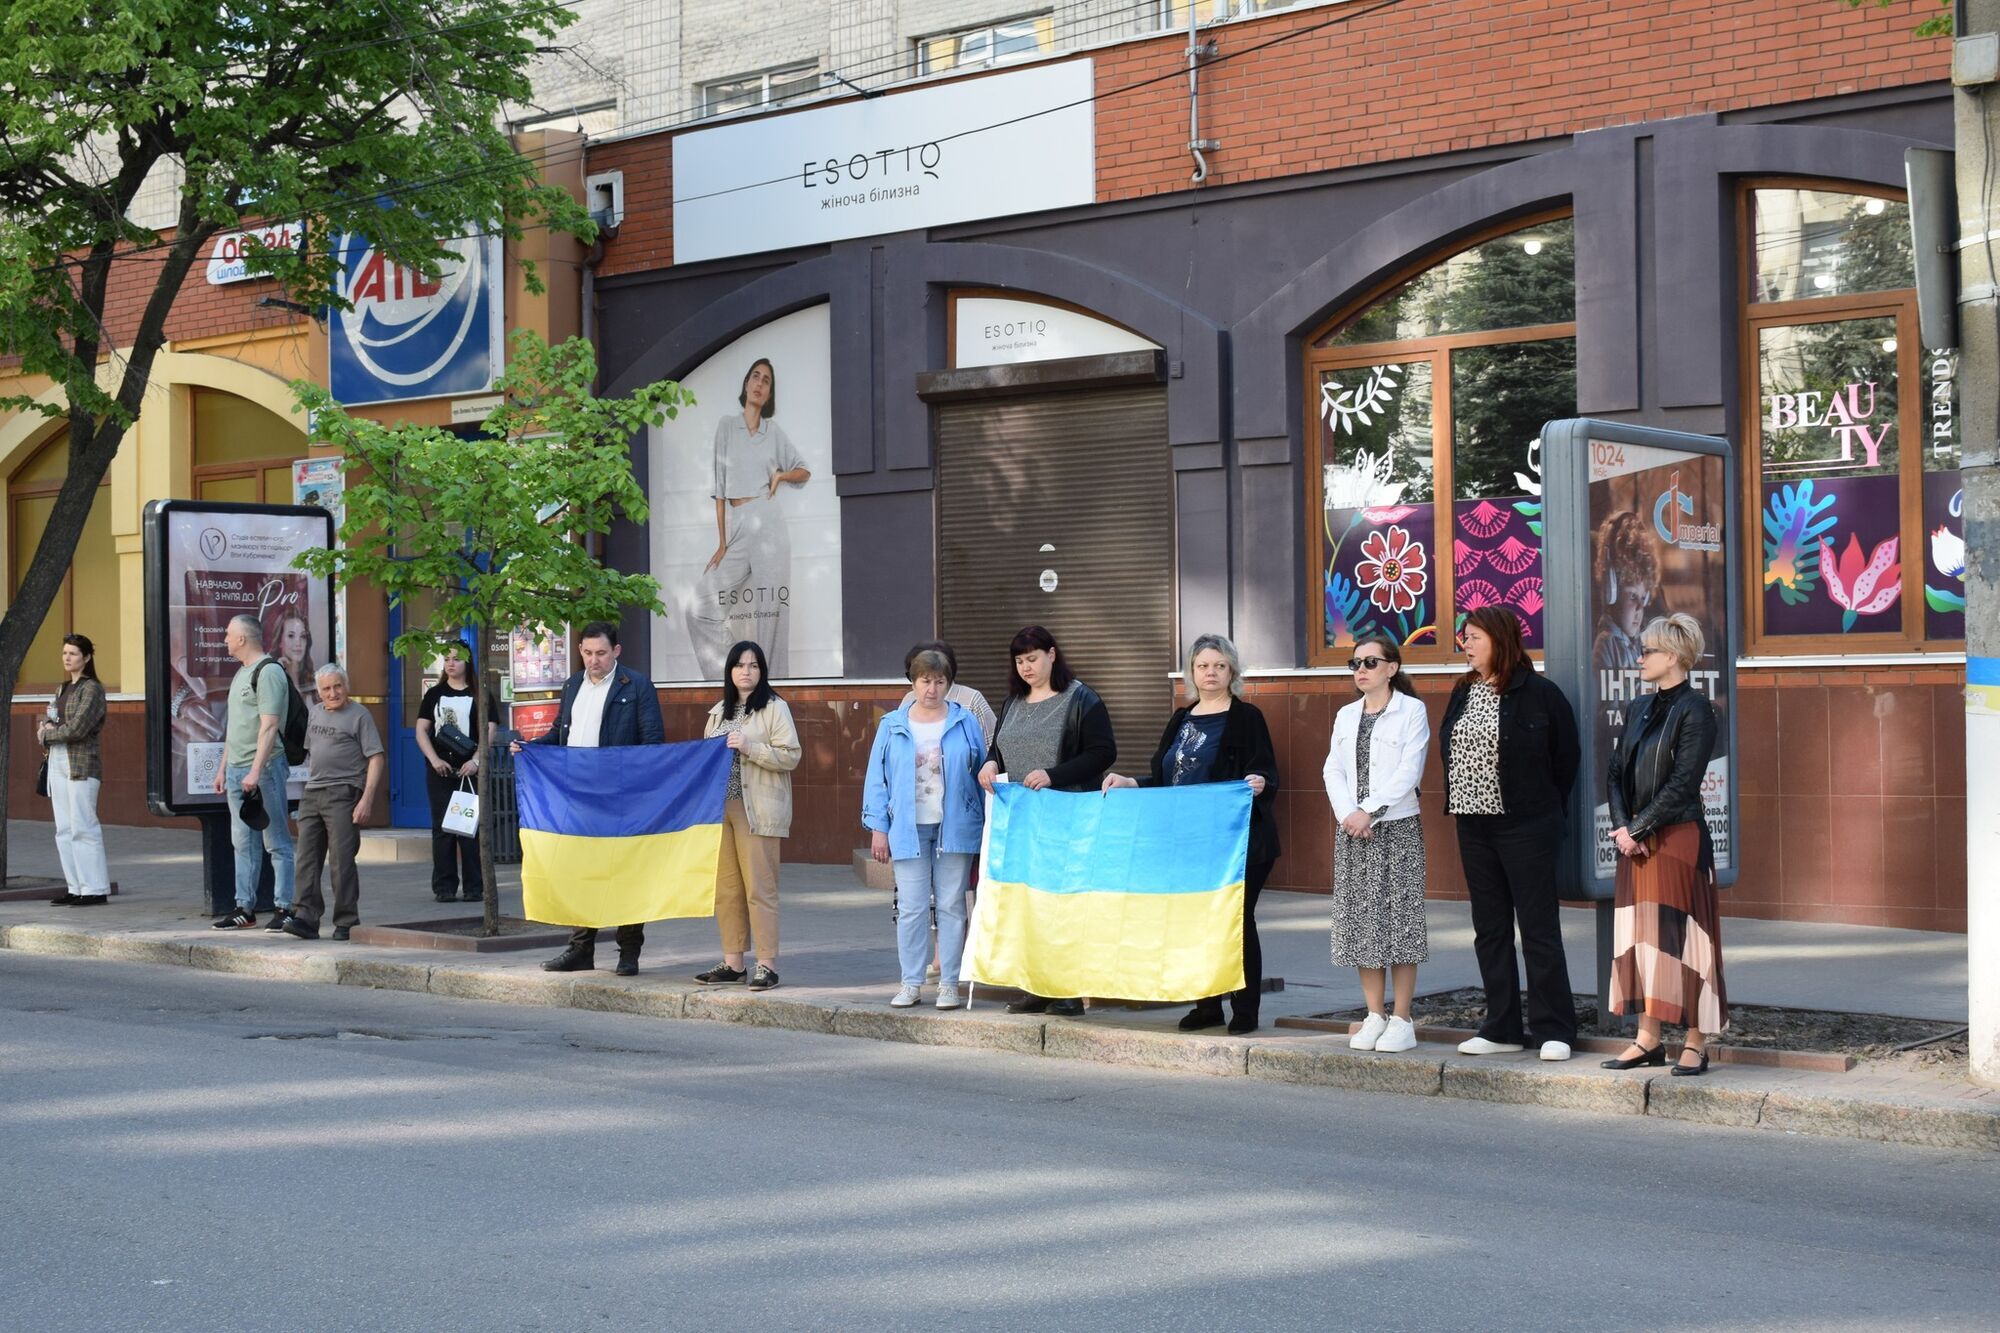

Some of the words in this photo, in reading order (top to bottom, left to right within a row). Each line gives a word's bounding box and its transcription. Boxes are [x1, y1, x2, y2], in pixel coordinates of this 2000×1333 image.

[804, 142, 941, 188] ESOTIQ
[821, 192, 865, 210] жіноча
[869, 184, 920, 202] білизна
[985, 320, 1046, 338] ESOTIQ
[1591, 442, 1625, 467] 1024
[195, 580, 243, 590] НАВЧАЄМО
[718, 586, 790, 606] ESOTIQ
[221, 592, 241, 601] НУЛЯ
[242, 593, 255, 602] ДО
[257, 579, 300, 623] Pro
[490, 644, 509, 652] 05:00
[1600, 669, 1720, 701] ІНТЕТ
[1606, 709, 1624, 726] ТА
